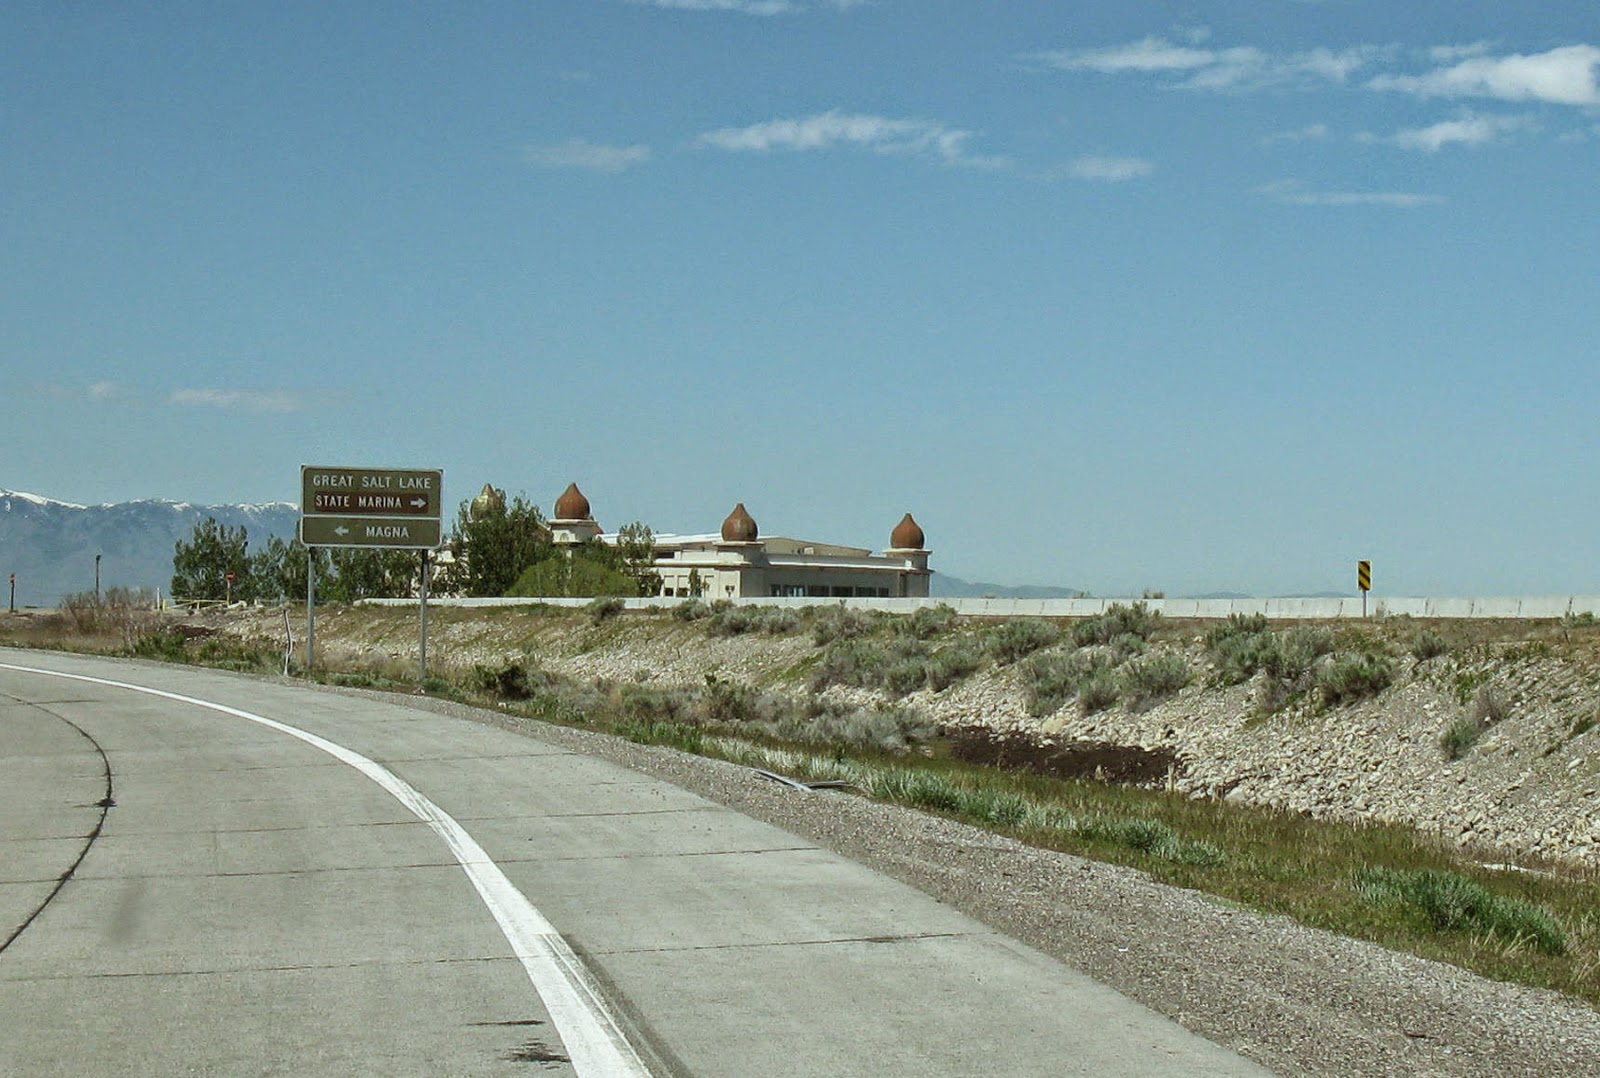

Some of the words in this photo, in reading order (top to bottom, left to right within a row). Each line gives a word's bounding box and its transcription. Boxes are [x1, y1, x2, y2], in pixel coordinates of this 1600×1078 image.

[313, 475, 353, 487] GREAT
[362, 476, 392, 488] SALT
[399, 477, 432, 489] LAKE
[315, 494, 350, 507] STATE
[358, 496, 403, 508] MARINA
[365, 526, 410, 538] MAGNA
